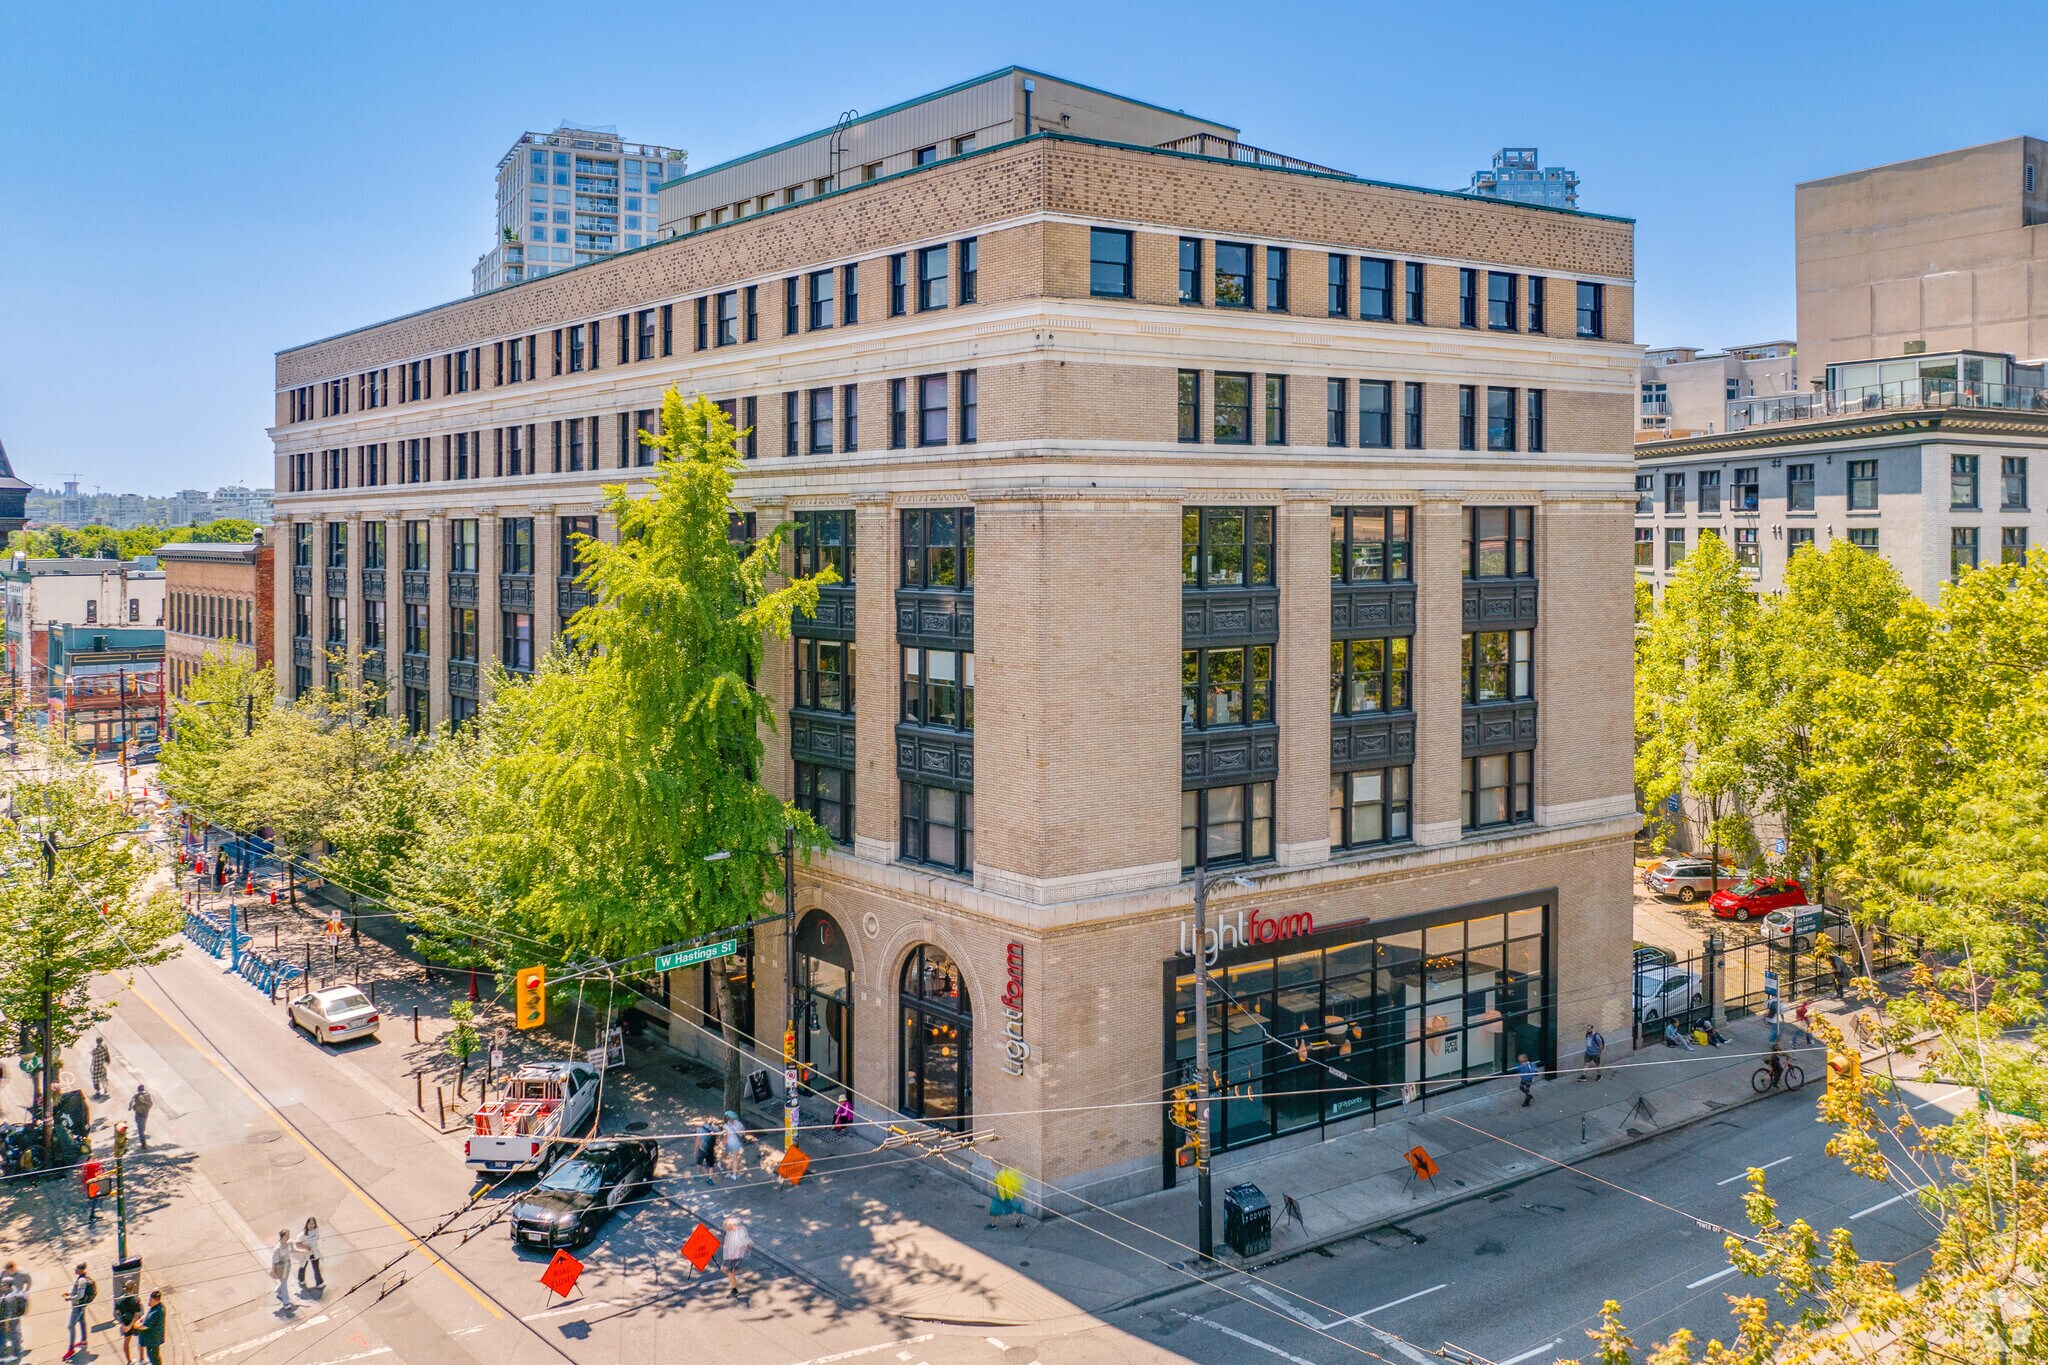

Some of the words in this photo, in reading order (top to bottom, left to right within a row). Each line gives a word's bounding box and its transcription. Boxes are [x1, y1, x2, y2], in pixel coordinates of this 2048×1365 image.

[1181, 909, 1313, 966] lightform
[660, 956, 672, 967] W
[675, 947, 718, 964] Hastings
[721, 942, 732, 953] St
[1001, 943, 1030, 1076] lightform
[1337, 1096, 1363, 1110] graypants
[551, 1274, 576, 1288] CLOSED
[553, 1266, 571, 1277] ROAD
